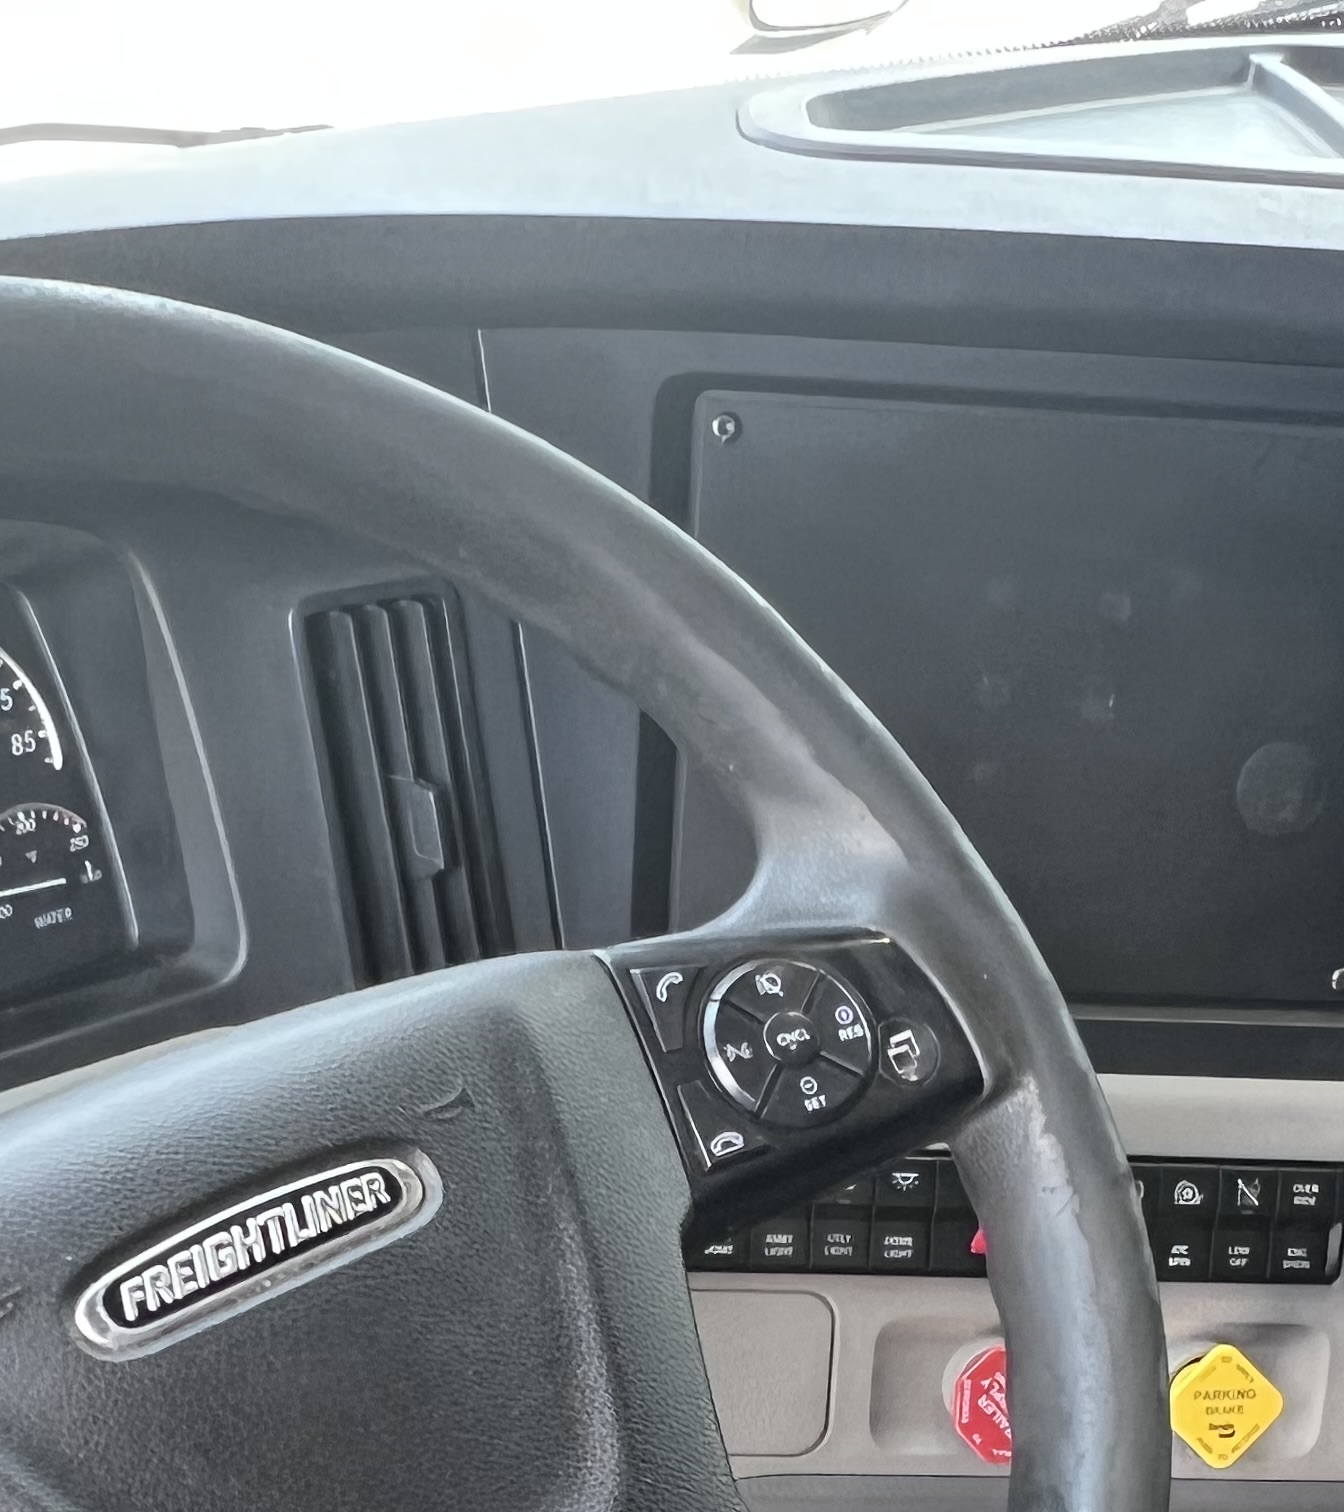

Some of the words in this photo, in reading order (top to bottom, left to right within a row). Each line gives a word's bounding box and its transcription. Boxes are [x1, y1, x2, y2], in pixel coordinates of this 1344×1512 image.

[11, 730, 36, 756] 85
[118, 1171, 392, 1322] FREIGHTLINER
[1193, 1388, 1257, 1401] PARKING
